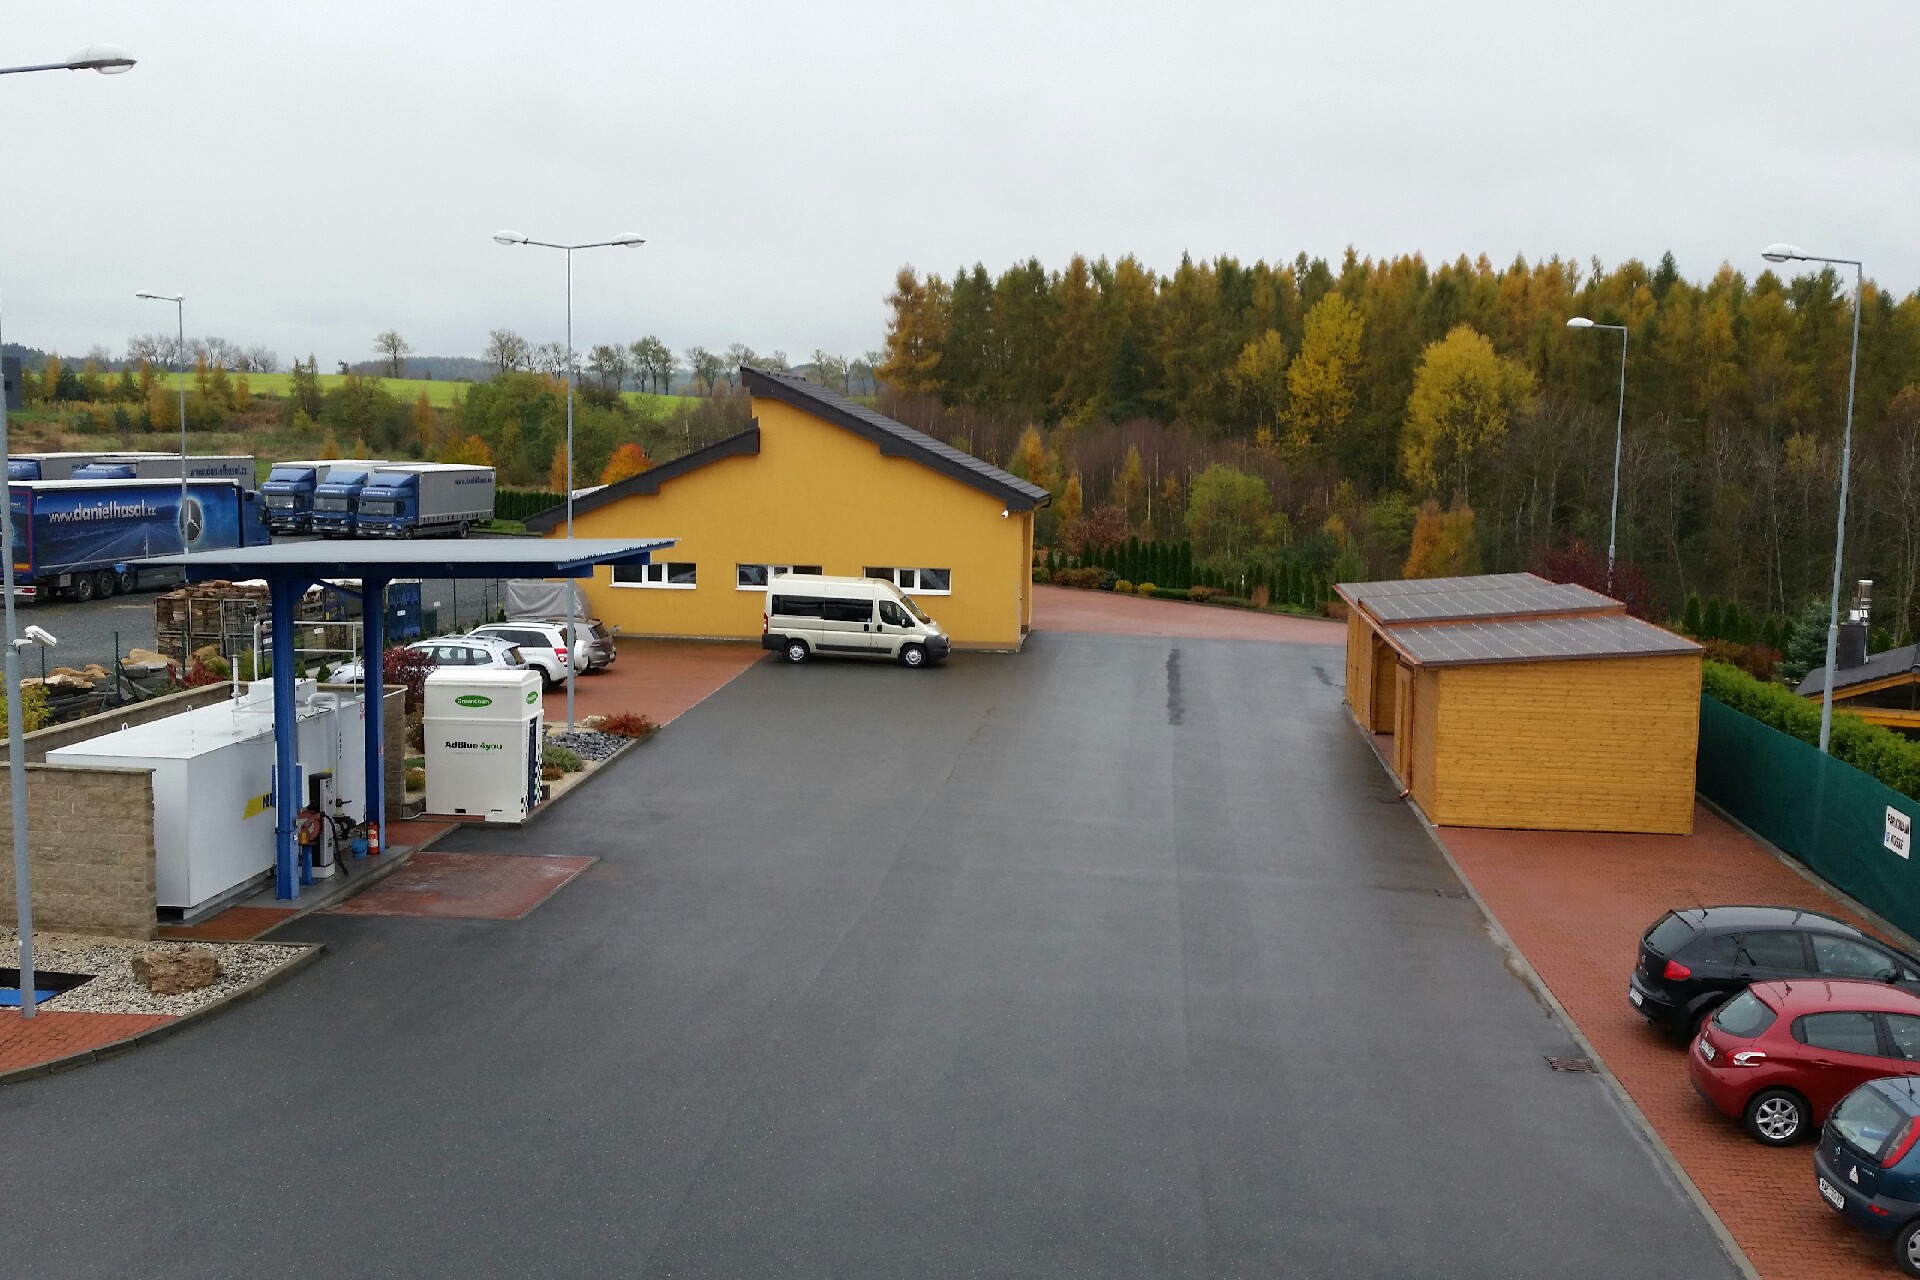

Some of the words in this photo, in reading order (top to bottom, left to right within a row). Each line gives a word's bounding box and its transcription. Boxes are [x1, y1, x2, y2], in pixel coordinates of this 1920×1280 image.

[49, 499, 156, 523] www.danielhasal.cz
[445, 741, 478, 749] AdBlue
[480, 742, 503, 750] 4you
